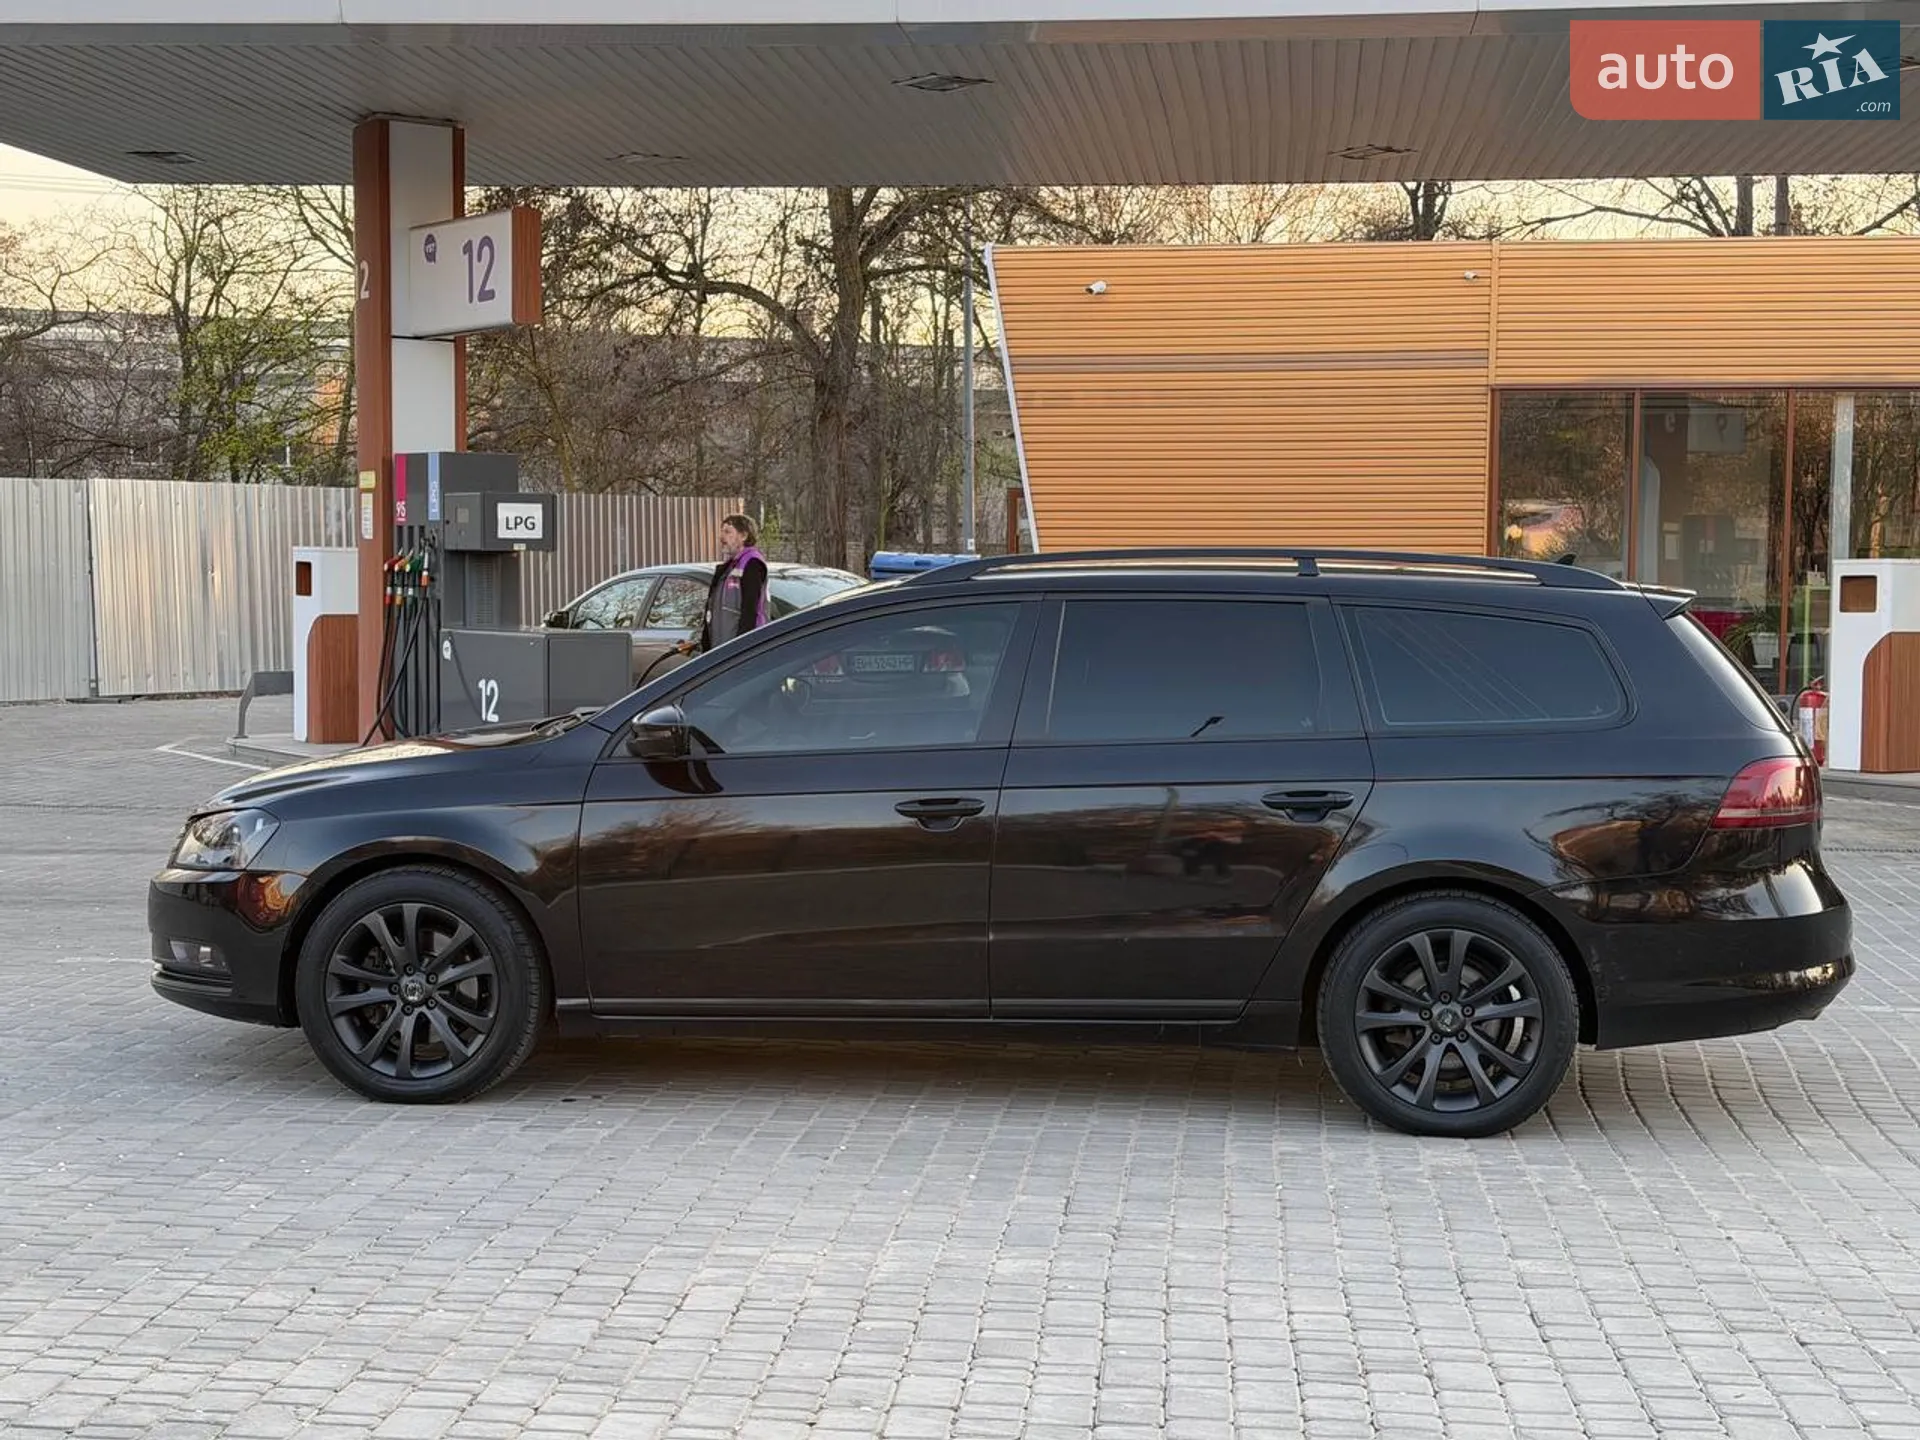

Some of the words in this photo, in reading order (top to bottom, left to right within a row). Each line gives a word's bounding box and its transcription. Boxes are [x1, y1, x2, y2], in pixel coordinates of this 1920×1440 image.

[462, 235, 495, 304] 12
[395, 501, 406, 517] 95
[505, 516, 536, 531] LPG
[478, 678, 499, 723] 12
